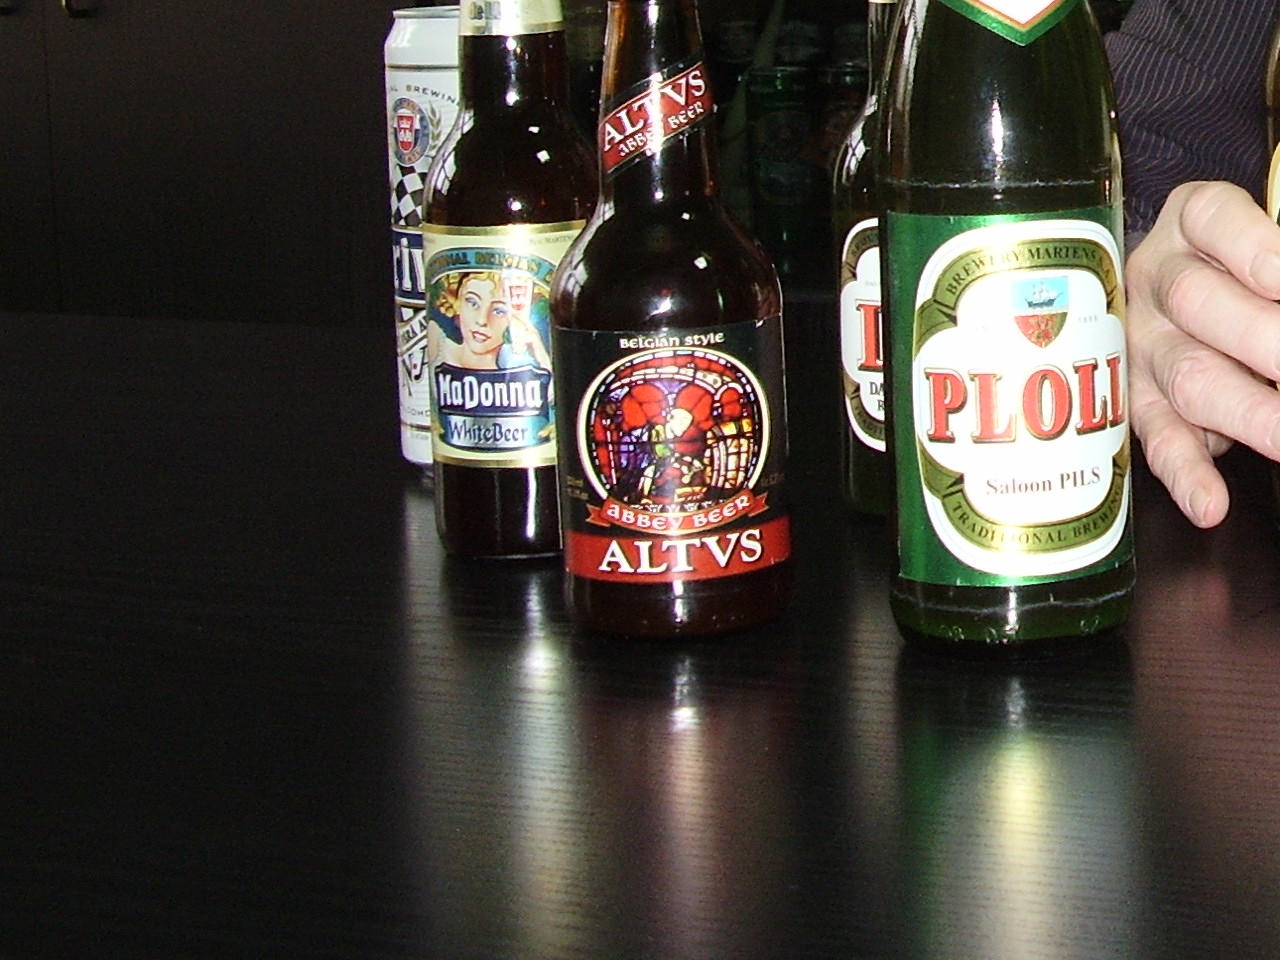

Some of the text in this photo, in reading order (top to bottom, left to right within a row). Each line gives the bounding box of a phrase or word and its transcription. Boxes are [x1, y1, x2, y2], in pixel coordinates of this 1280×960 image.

[406, 84, 459, 105] BREWIN
[603, 70, 706, 152] ALTVS
[667, 101, 705, 129] BEER
[945, 247, 1023, 296] BREWERY
[1028, 245, 1098, 262] MARTENS
[438, 373, 543, 410] MaDonna
[924, 352, 1126, 444] PLOLL
[447, 419, 528, 443] WhiteBeer
[986, 466, 1101, 495] Saloon PILS
[606, 494, 751, 531] ABBEY BEER
[598, 529, 763, 574] ALTVS
